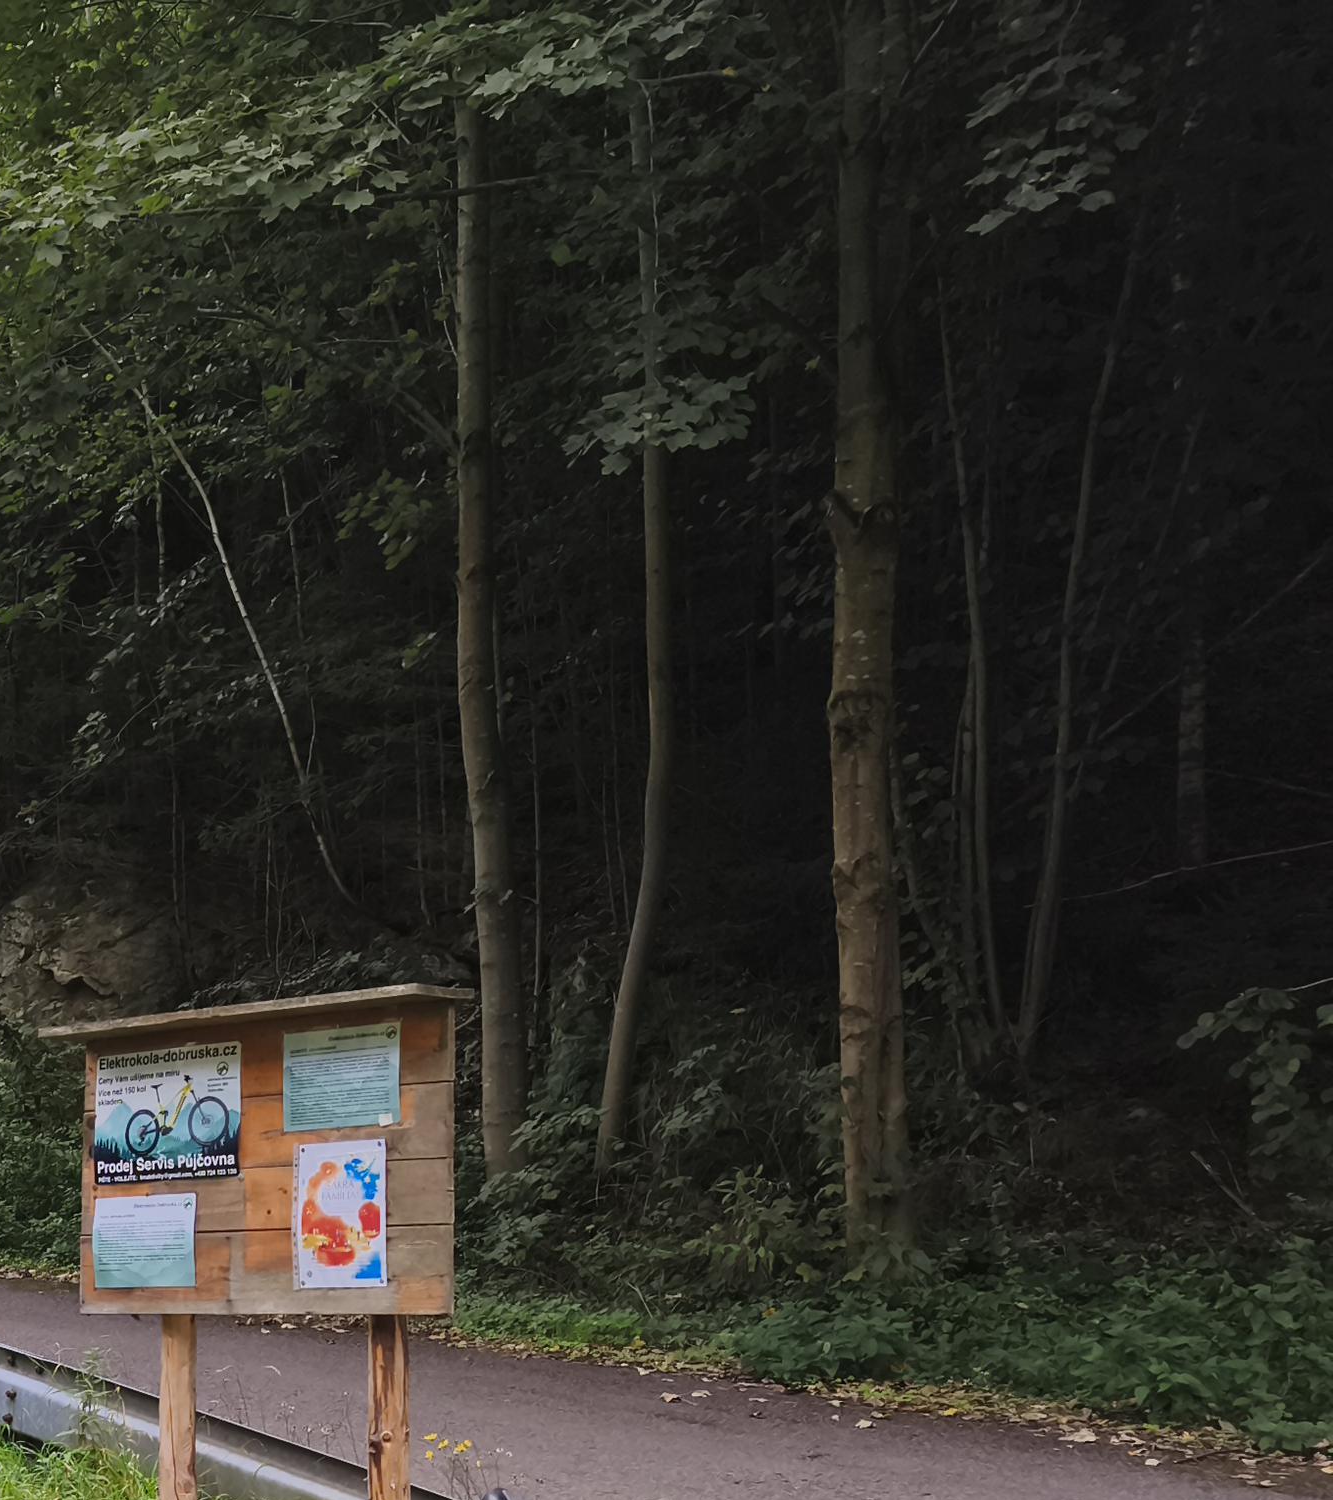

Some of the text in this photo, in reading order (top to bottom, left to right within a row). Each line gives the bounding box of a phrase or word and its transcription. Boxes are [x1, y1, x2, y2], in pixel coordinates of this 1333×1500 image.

[98, 1045, 238, 1071] Elektrokola-dobruska.cz
[136, 1085, 147, 1093] kol
[97, 1153, 235, 1175] Prodej Servis Půjčovna
